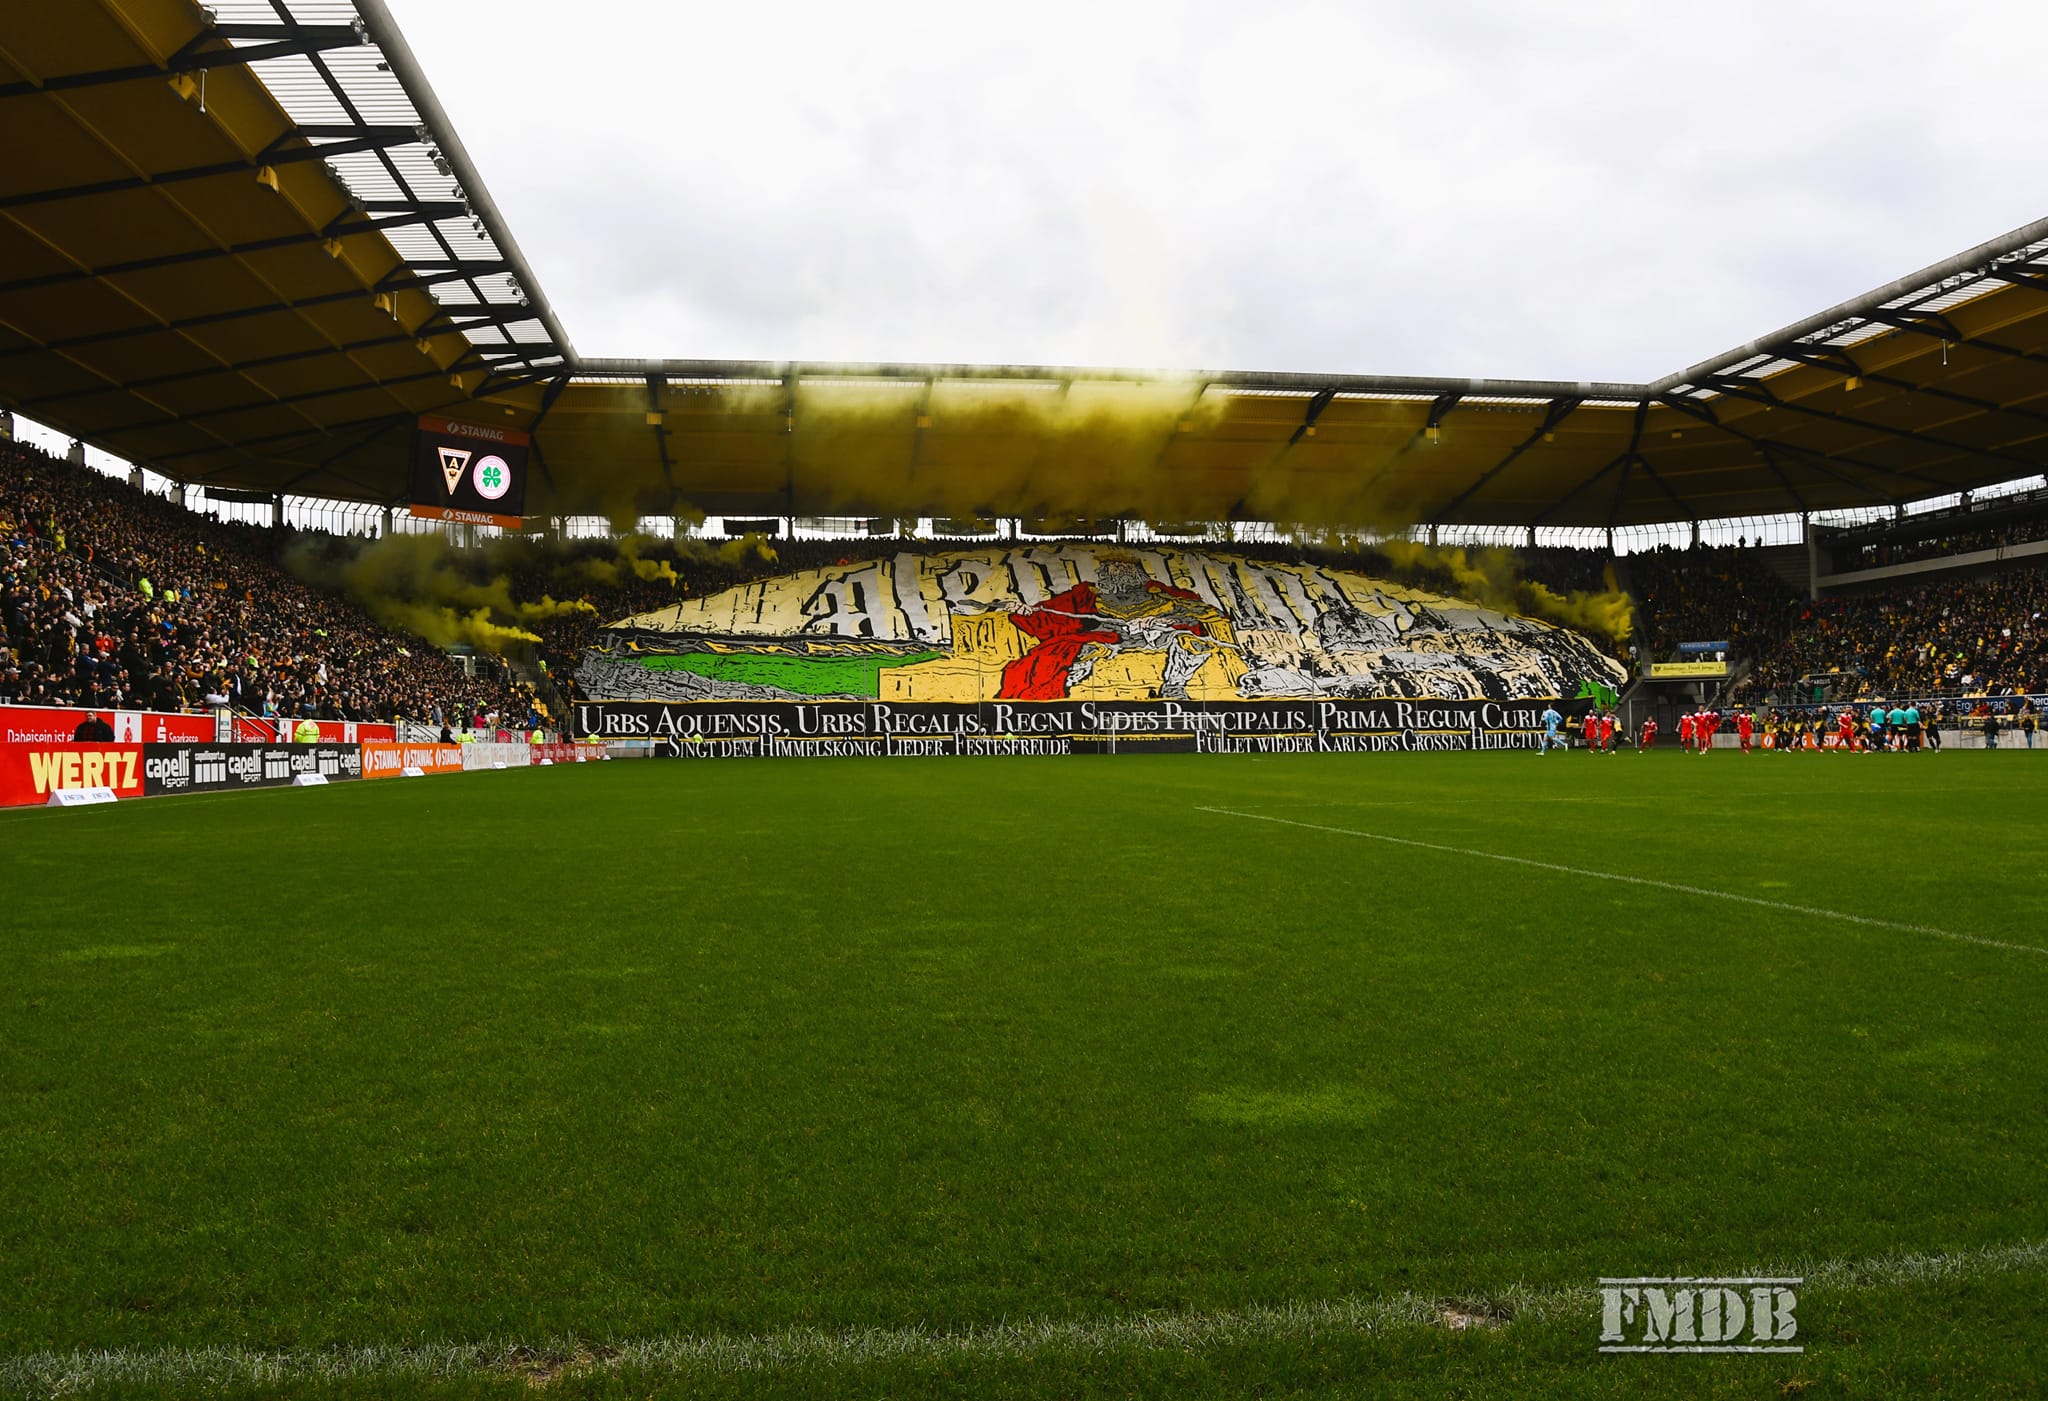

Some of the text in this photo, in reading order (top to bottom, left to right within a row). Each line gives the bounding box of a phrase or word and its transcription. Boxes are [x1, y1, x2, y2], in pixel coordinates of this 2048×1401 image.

[462, 424, 503, 440] STAWAG
[455, 511, 494, 524] STAWAG
[580, 705, 649, 734] URBS
[655, 705, 790, 738] AQUENSIS,
[795, 704, 865, 734] URBS
[871, 703, 988, 737] REGALIS,
[993, 703, 1073, 734] REGNI
[1081, 702, 1158, 732] SEDES
[1164, 702, 1314, 733] PRINCIPALIS,
[1318, 702, 1392, 730] PRIMA
[1395, 701, 1476, 730] REGUM
[668, 733, 716, 758] SINGT
[721, 740, 755, 758] DEM
[759, 733, 880, 758] HIMMELSKÖNIG
[1257, 735, 1313, 753] WIEDER
[1317, 728, 1367, 753] KARLS
[1372, 735, 1399, 752] DES
[1402, 728, 1467, 752] GROSSEN
[146, 750, 189, 785] capelli
[229, 749, 261, 781] capelli
[290, 748, 316, 774] capelli
[374, 750, 401, 770] STAWAG
[410, 749, 433, 767] STAWAG
[442, 749, 461, 766] STAWAG
[29, 751, 138, 793] WERTZ
[244, 773, 261, 783] SPORT
[166, 777, 189, 788] SPORT
